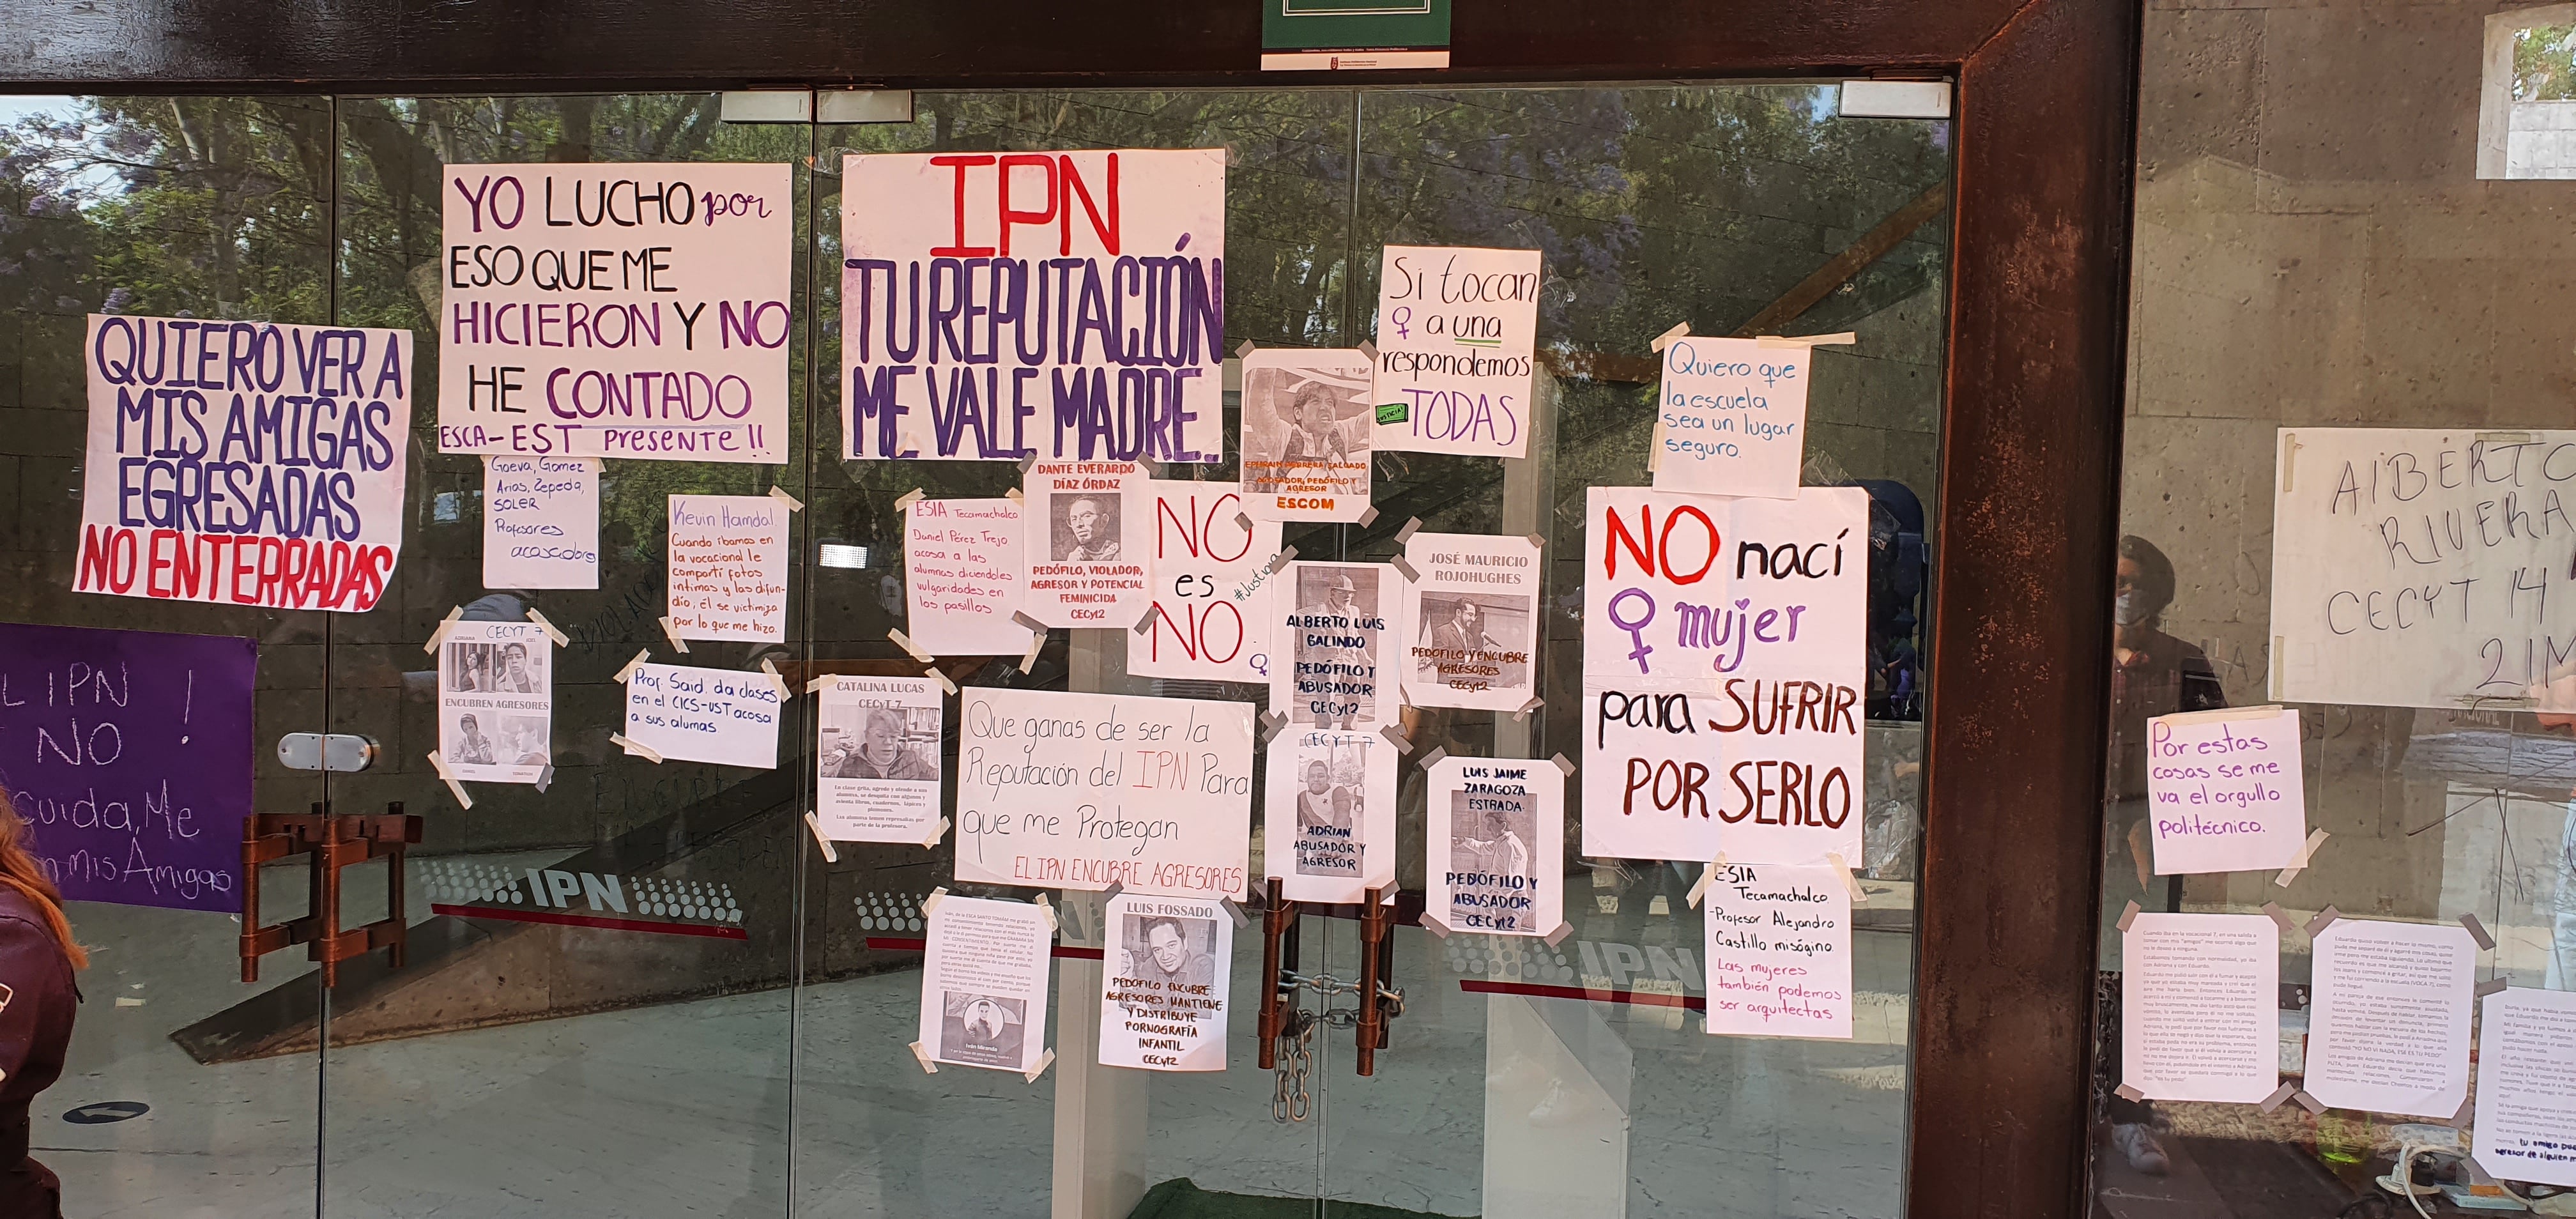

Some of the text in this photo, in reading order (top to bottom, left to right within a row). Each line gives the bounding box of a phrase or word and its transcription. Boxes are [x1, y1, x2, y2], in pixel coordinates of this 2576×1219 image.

[454, 175, 695, 232] YO LUCHO
[930, 153, 1120, 257] IPN
[532, 247, 678, 293] QUE ME
[1390, 254, 1537, 303] Si tocan
[845, 233, 1223, 367] TU REPUTACIÓN
[454, 300, 790, 349] HICIERON NO
[1427, 315, 1501, 337] a una
[96, 318, 402, 399] QUIERO VER A
[1383, 348, 1529, 381] respondemos
[1669, 341, 1795, 388] Quiero que
[469, 365, 752, 420] HE CONTADO
[1666, 381, 1768, 410] la escuela
[853, 365, 1038, 459] ME VALE
[1402, 388, 1516, 445] TODAS
[116, 387, 394, 471] MIS AMIGAS
[1664, 413, 1795, 441] sea un lugar
[539, 456, 585, 473] Gomez
[1038, 463, 1135, 474] DANTE EVERARDO
[1328, 463, 1366, 471] SALGADO
[119, 457, 360, 540] EGRESADAS
[1277, 496, 1334, 510] ESCOM
[673, 500, 716, 526] Kevin
[916, 501, 1018, 519] ESIA Tecamachalco
[912, 529, 944, 542] Daniel
[1158, 493, 1252, 562] NO
[671, 532, 712, 547] Cuando
[1604, 504, 1850, 585] NO nací
[674, 548, 762, 564] la vocacional le
[1429, 552, 1528, 567] JOSÉ MAURICIO
[79, 524, 392, 611] NO ENTERRADAS
[728, 564, 762, 581] fotos
[914, 563, 1013, 581] alumnas diciendoles
[1089, 565, 1143, 576] VIOLADOR,
[1435, 571, 1521, 584] ROJOHUGHES
[917, 579, 985, 597] vulgaridades
[1031, 579, 1145, 589] AGRESOR POTENCIAL
[1176, 574, 1214, 597] es
[734, 597, 778, 617] victimiza
[944, 598, 992, 615] pasillos
[1060, 594, 1117, 603] FEMINICIDA
[486, 625, 526, 638] CECYT
[1153, 601, 1243, 663] NO
[1287, 615, 1384, 630] ALBERTO LUIS
[1307, 634, 1365, 648] GALINDO
[1674, 598, 1806, 672] mujer
[1476, 650, 1529, 663] ENCUBRE
[1295, 659, 1364, 676] PEDÓFILO
[1438, 663, 1500, 675] AGRESORES
[49, 661, 128, 707] IPN
[714, 679, 777, 703] da clases
[837, 682, 925, 693] CATALINA LUCAS
[1298, 681, 1373, 698] ABUSADOR
[445, 698, 549, 710] ENCUBREN AGRESORES
[632, 694, 771, 723] en el acosa
[895, 700, 902, 709] 7
[1599, 678, 1857, 750] para SUFRIR
[645, 716, 665, 726] sus
[969, 700, 1209, 742] Que la
[38, 717, 121, 765] NO
[1305, 732, 1354, 747] CECYT
[2153, 721, 2268, 758] Por estas
[1089, 749, 1188, 791] del IPN
[1463, 767, 1528, 779] LUIS JAIME
[2153, 767, 2211, 779] cosas
[1464, 783, 1526, 796] ZARAGOZA
[1624, 758, 1850, 829] POR SERLO
[2157, 782, 2280, 808] va el orgullo
[146, 779, 199, 839] Me
[963, 804, 1178, 864] que me Protegan
[1307, 825, 1351, 837] ADRIAN
[2159, 814, 2266, 839] politécnico.
[1294, 840, 1366, 856] ABUSADOR Y
[123, 836, 231, 900] Amigas
[1303, 856, 1356, 870] AGRESOR
[1151, 862, 1242, 893] AGRESORES
[1446, 871, 1524, 889] PEDÓFILO
[525, 868, 628, 913] IPN
[1127, 902, 1213, 917] LUIS FOSSADO
[1453, 894, 1531, 910] ABUSADOR
[1773, 910, 1834, 931] Alejandro
[1716, 930, 1767, 951] Castillo
[1577, 940, 1703, 990] IPN
[1719, 958, 1807, 981] Las mujeres
[1717, 976, 1841, 1000] también podemos
[1106, 992, 1223, 1011] AGRESORES MANTIENE
[1747, 999, 1833, 1022] arquitectas
[1137, 1008, 1198, 1022] DISTRIBUYE
[1126, 1022, 1197, 1038] PORNOGRAFÍA
[1139, 1038, 1184, 1051] INFANTIL
